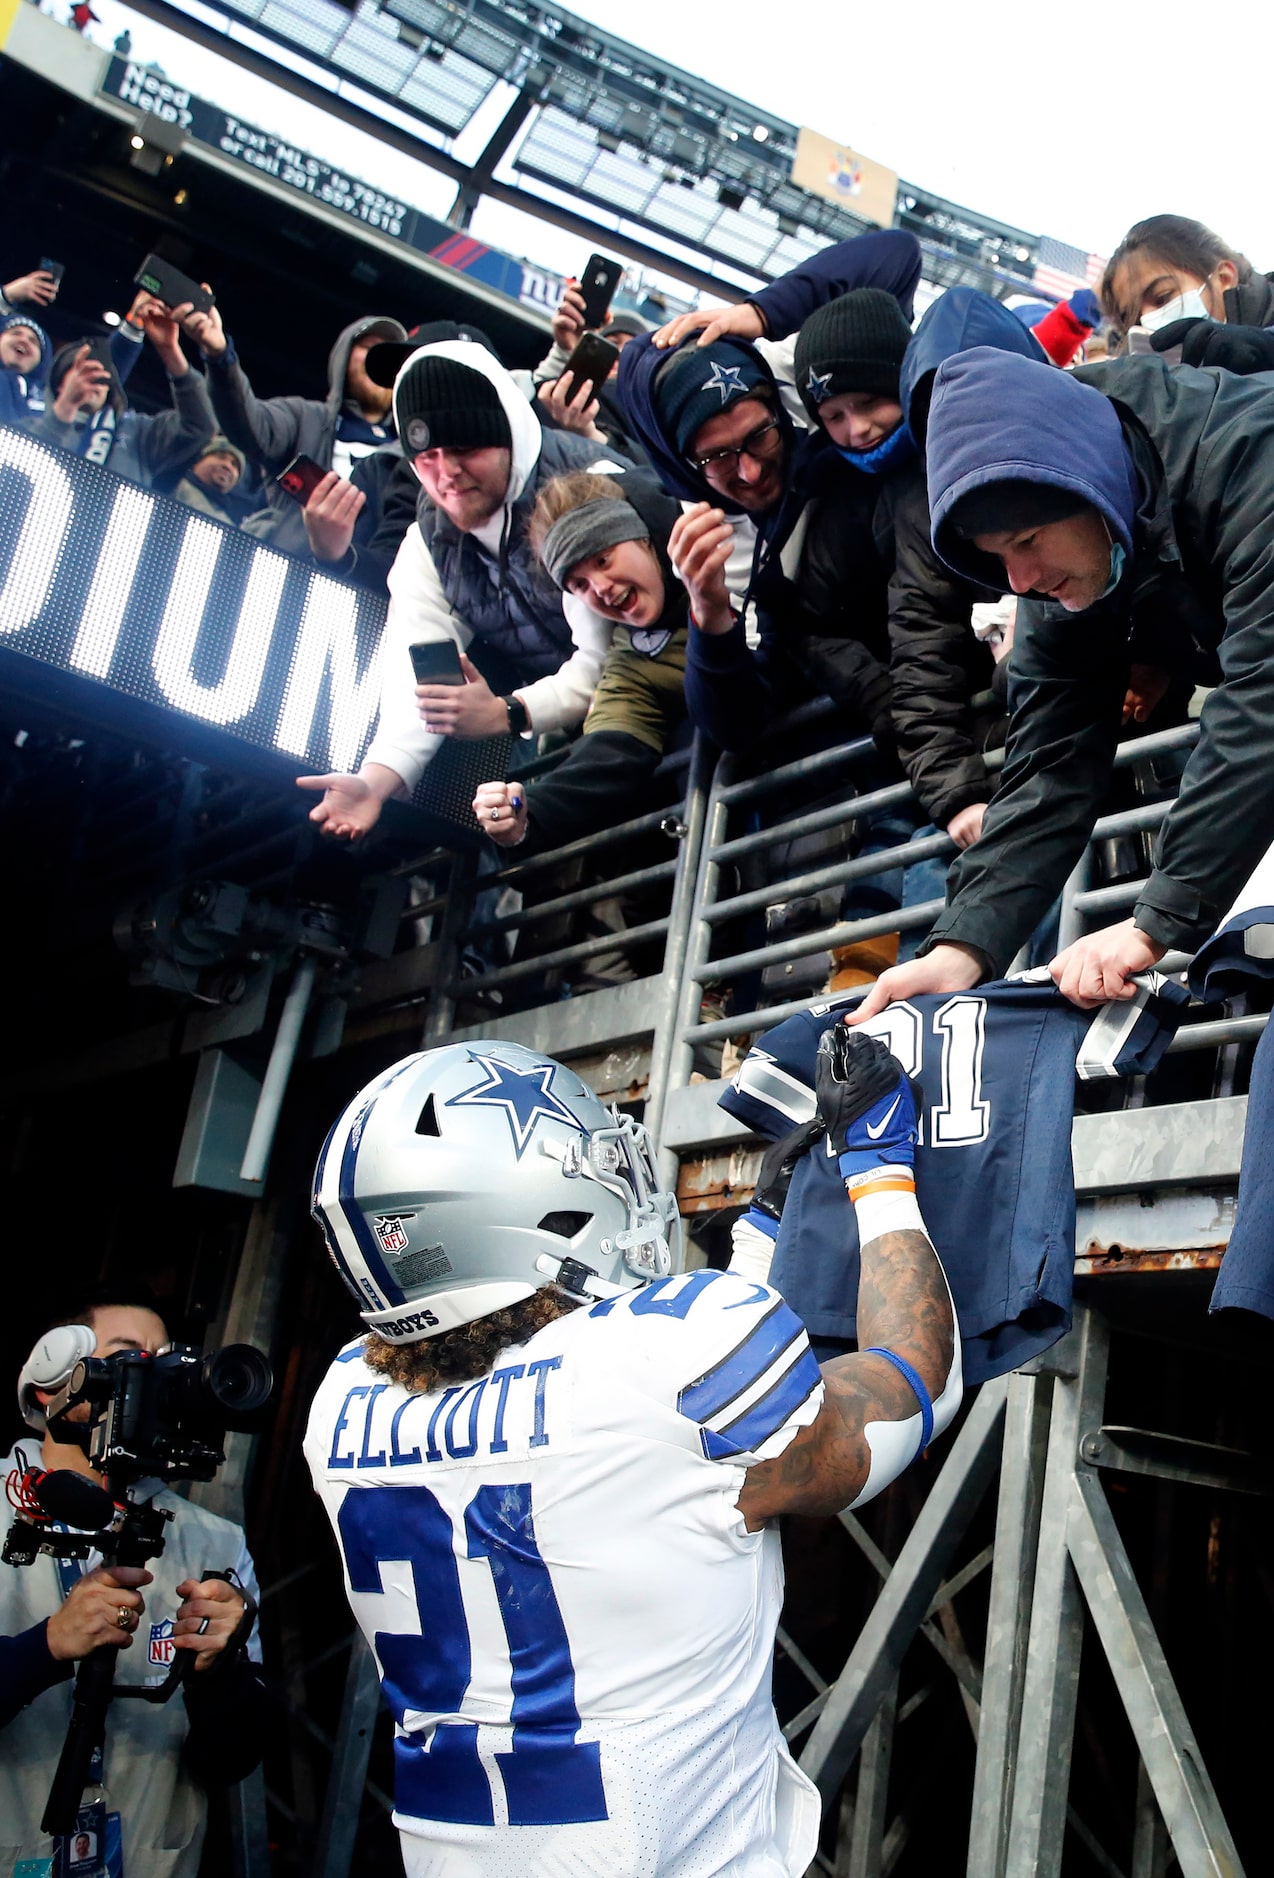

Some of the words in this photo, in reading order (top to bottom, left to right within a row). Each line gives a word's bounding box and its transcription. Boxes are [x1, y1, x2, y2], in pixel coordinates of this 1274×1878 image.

[118, 80, 194, 137] Help?
[124, 63, 191, 110] Need
[219, 135, 244, 156] or
[242, 147, 280, 177] call
[225, 117, 267, 152] Text
[330, 173, 351, 194] to
[382, 1232, 405, 1250] NFL
[327, 1354, 565, 1469] ELLIOTT
[151, 1639, 176, 1662] NF
[338, 1482, 609, 1826] 21
